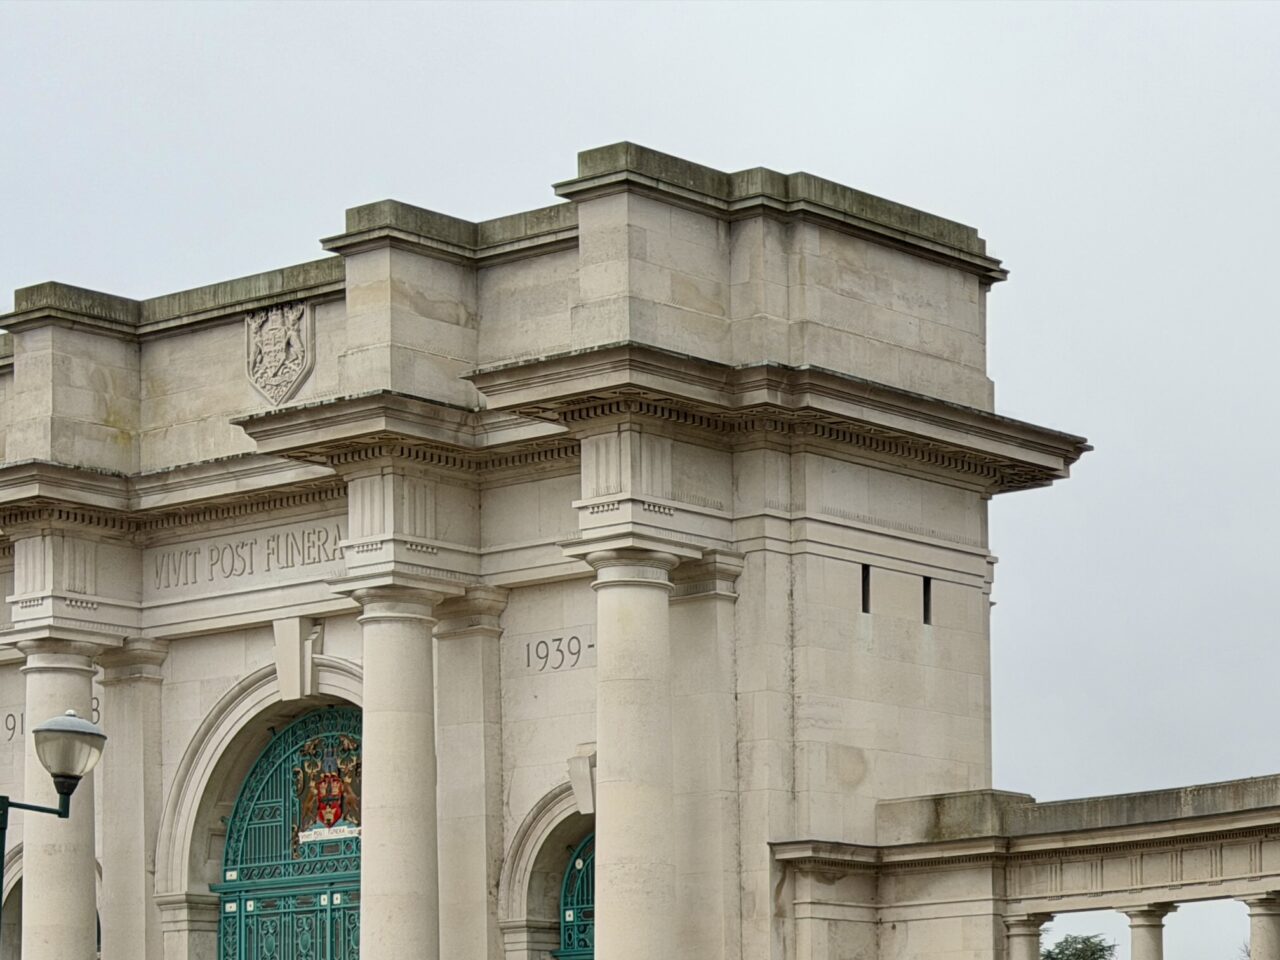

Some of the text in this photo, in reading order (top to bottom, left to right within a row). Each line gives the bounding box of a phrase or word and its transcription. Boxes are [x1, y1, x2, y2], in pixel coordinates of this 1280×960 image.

[153, 524, 346, 590] VIVIT POST FUNERA
